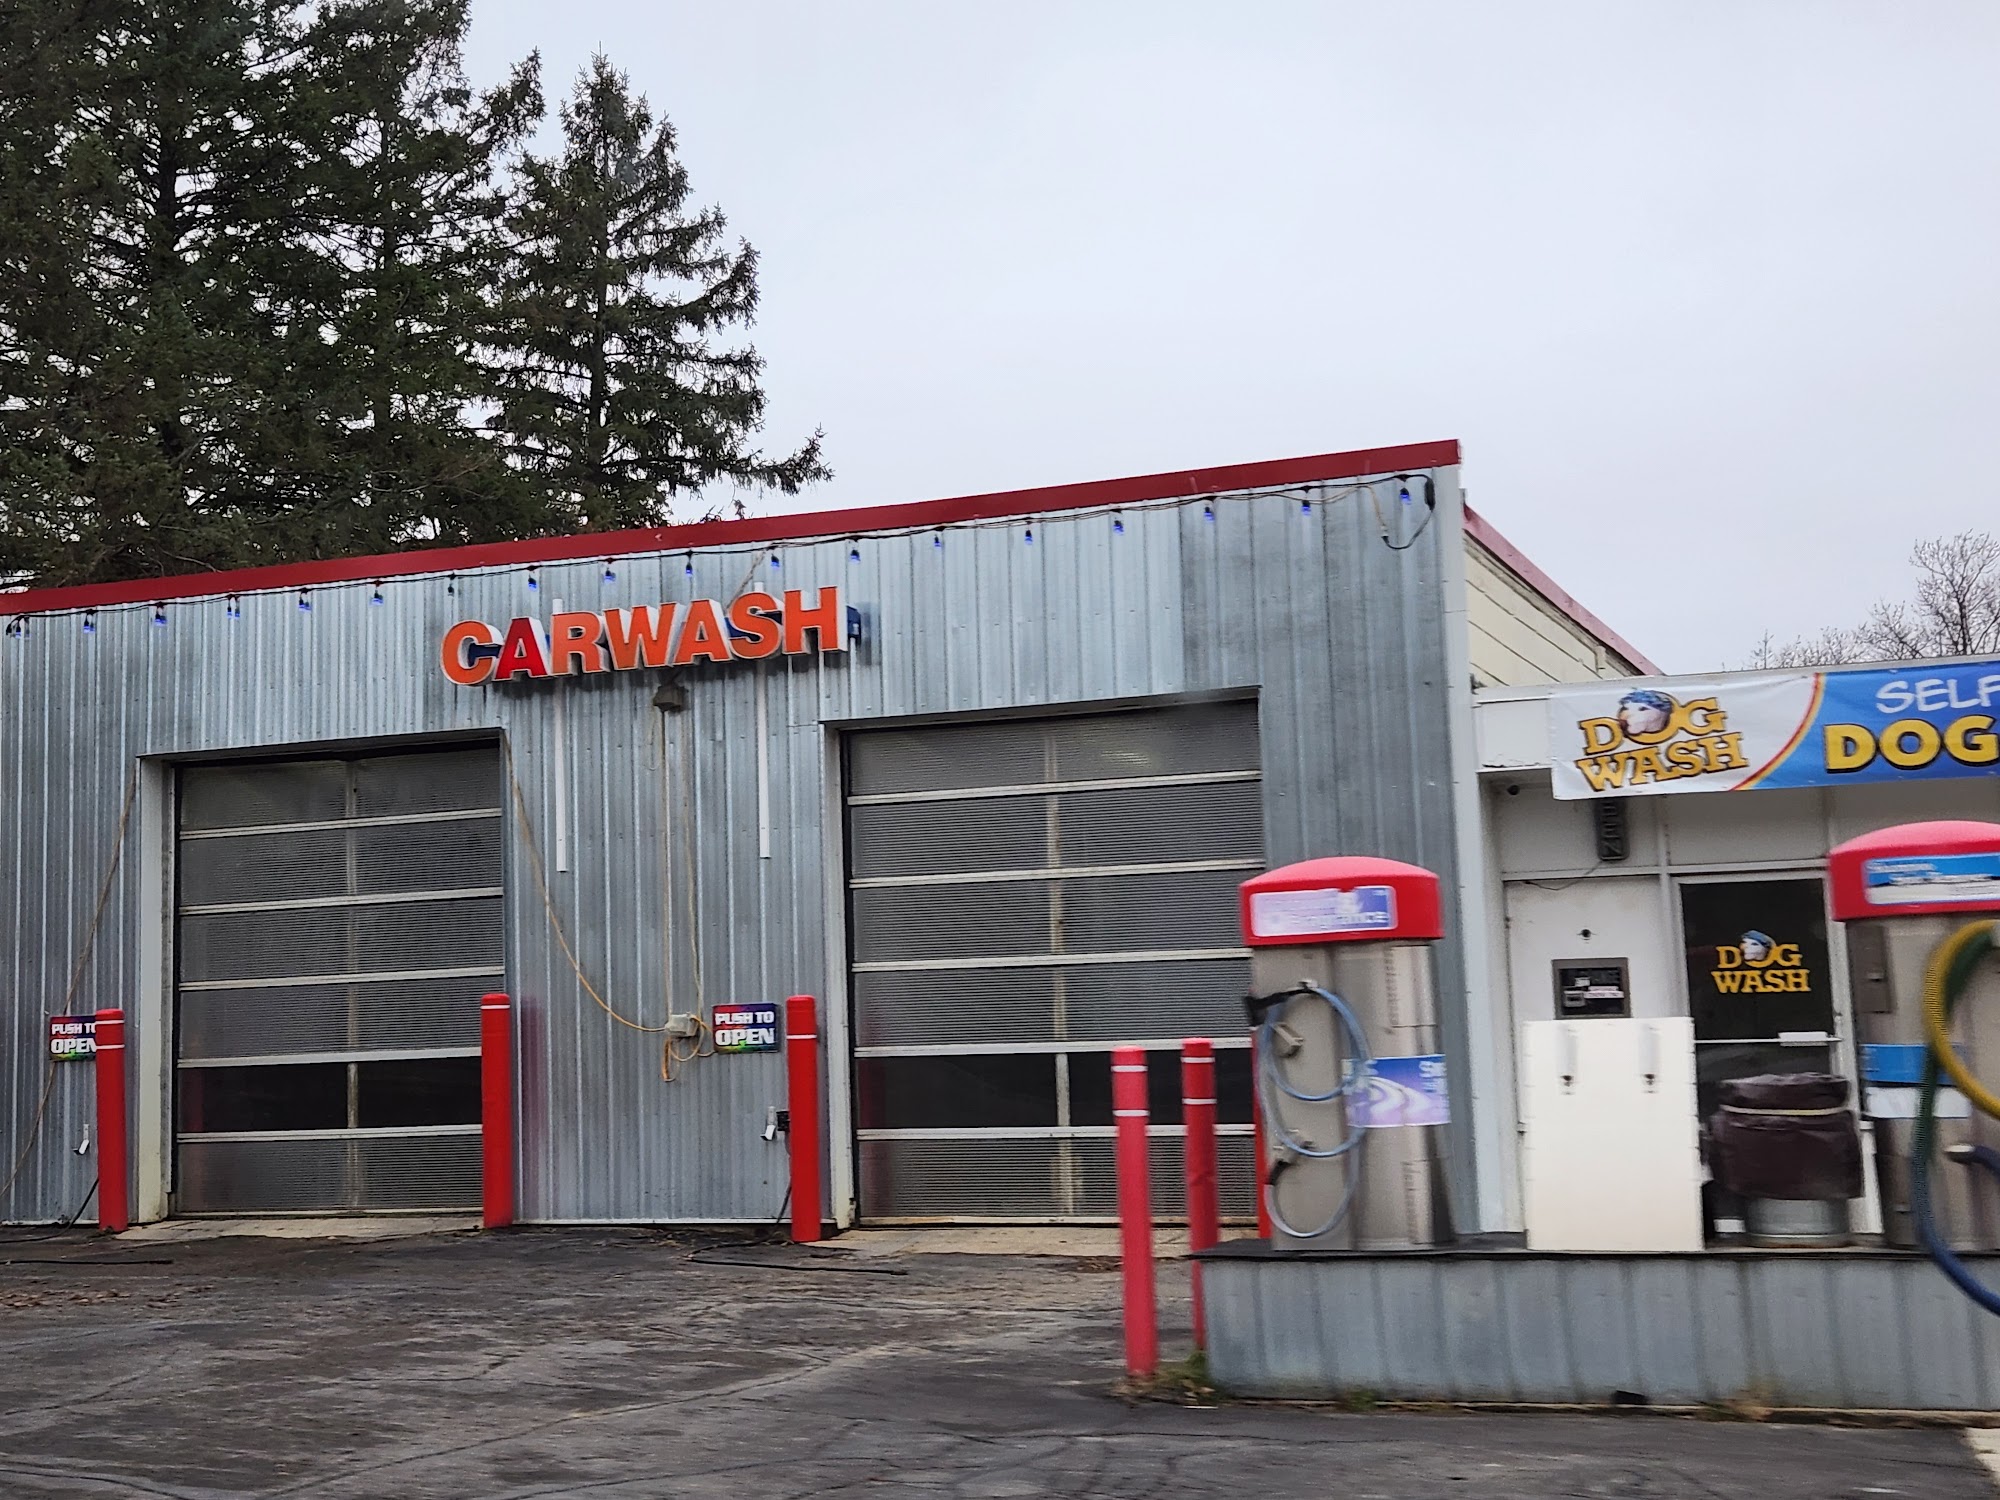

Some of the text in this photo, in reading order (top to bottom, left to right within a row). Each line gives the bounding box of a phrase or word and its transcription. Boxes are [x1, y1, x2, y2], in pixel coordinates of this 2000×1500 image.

[440, 586, 848, 686] CARWASH
[1876, 675, 2000, 713] SELF
[1577, 690, 1728, 756] DOG
[1574, 732, 1749, 792] WASH
[1823, 714, 2000, 774] DOG
[1715, 931, 1803, 969] DOG
[1710, 969, 1812, 994] WASH
[51, 1023, 83, 1035] PUSH
[715, 1011, 775, 1025] PUSH TO
[715, 1028, 775, 1046] OPEN
[51, 1038, 97, 1054] OPEN
